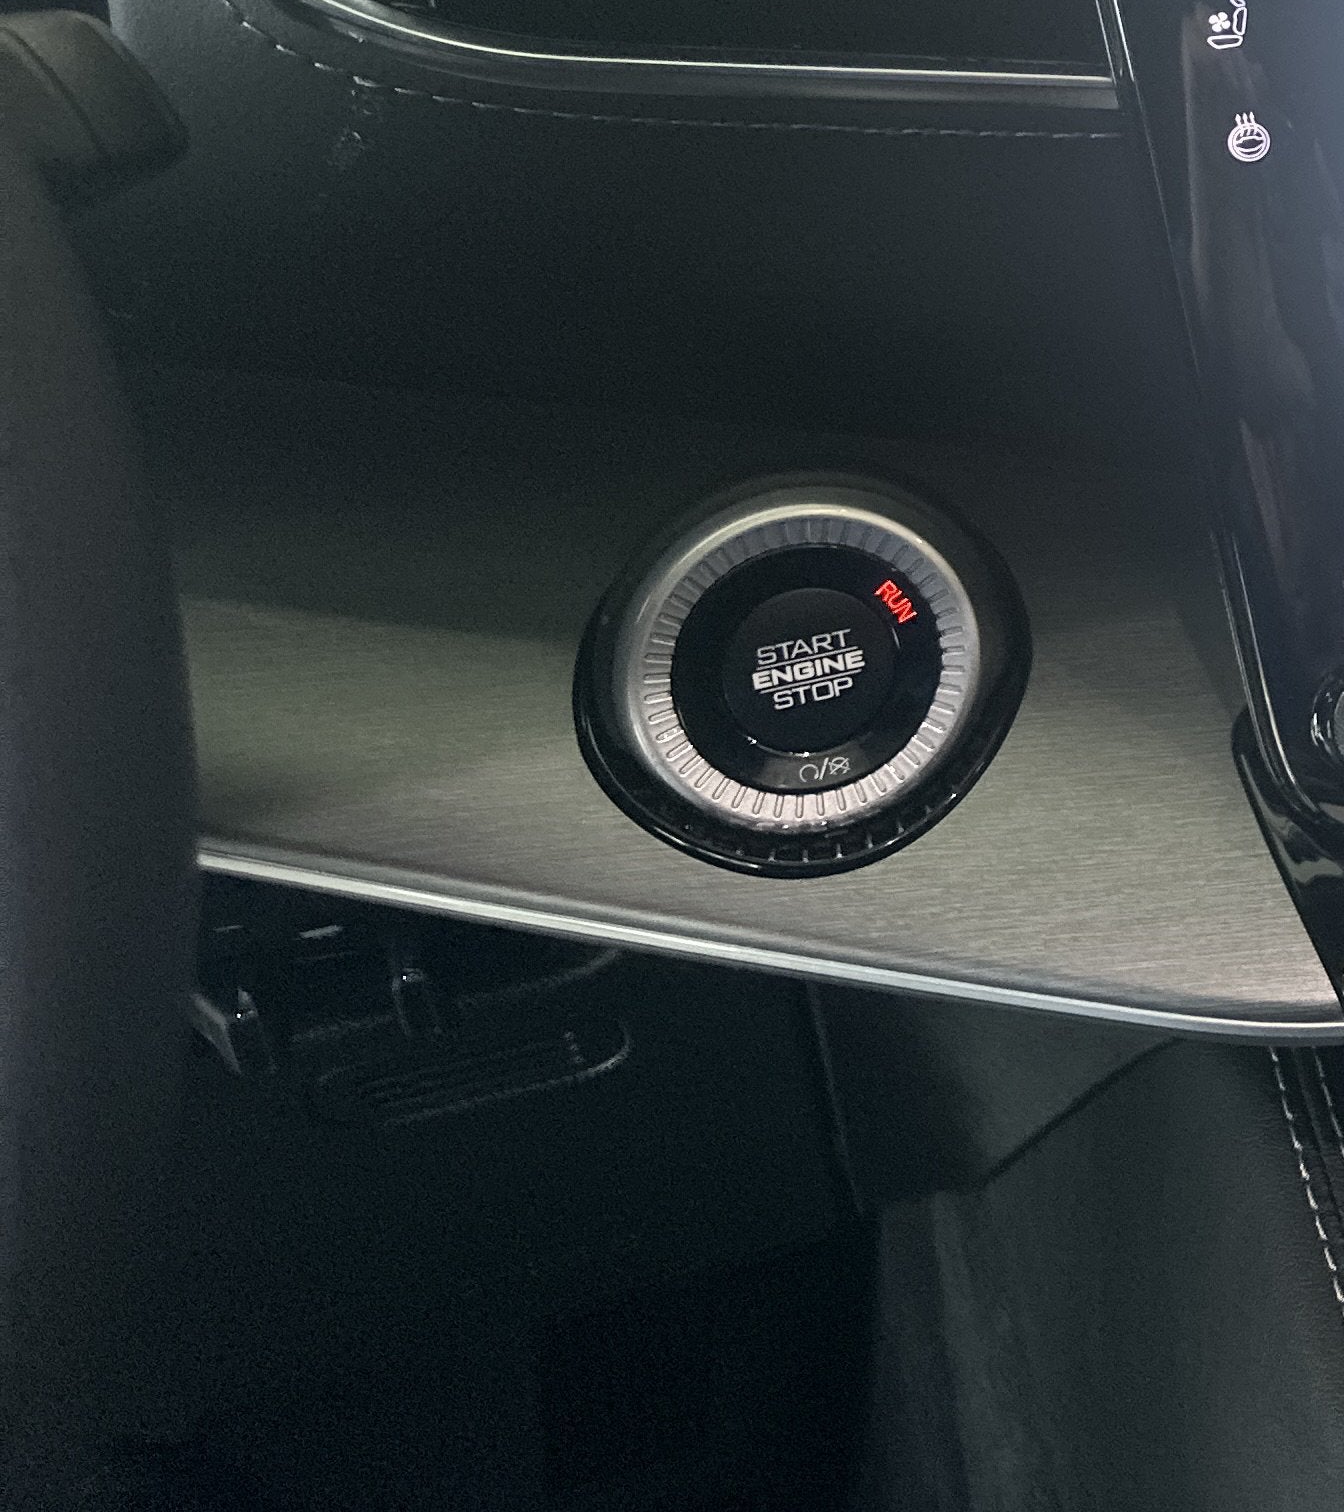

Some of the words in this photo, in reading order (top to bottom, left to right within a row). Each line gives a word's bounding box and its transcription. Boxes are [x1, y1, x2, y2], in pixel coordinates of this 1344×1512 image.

[874, 580, 918, 623] RUN
[757, 628, 851, 664] START
[752, 649, 865, 691] ENGINE
[773, 676, 853, 711] STOP
